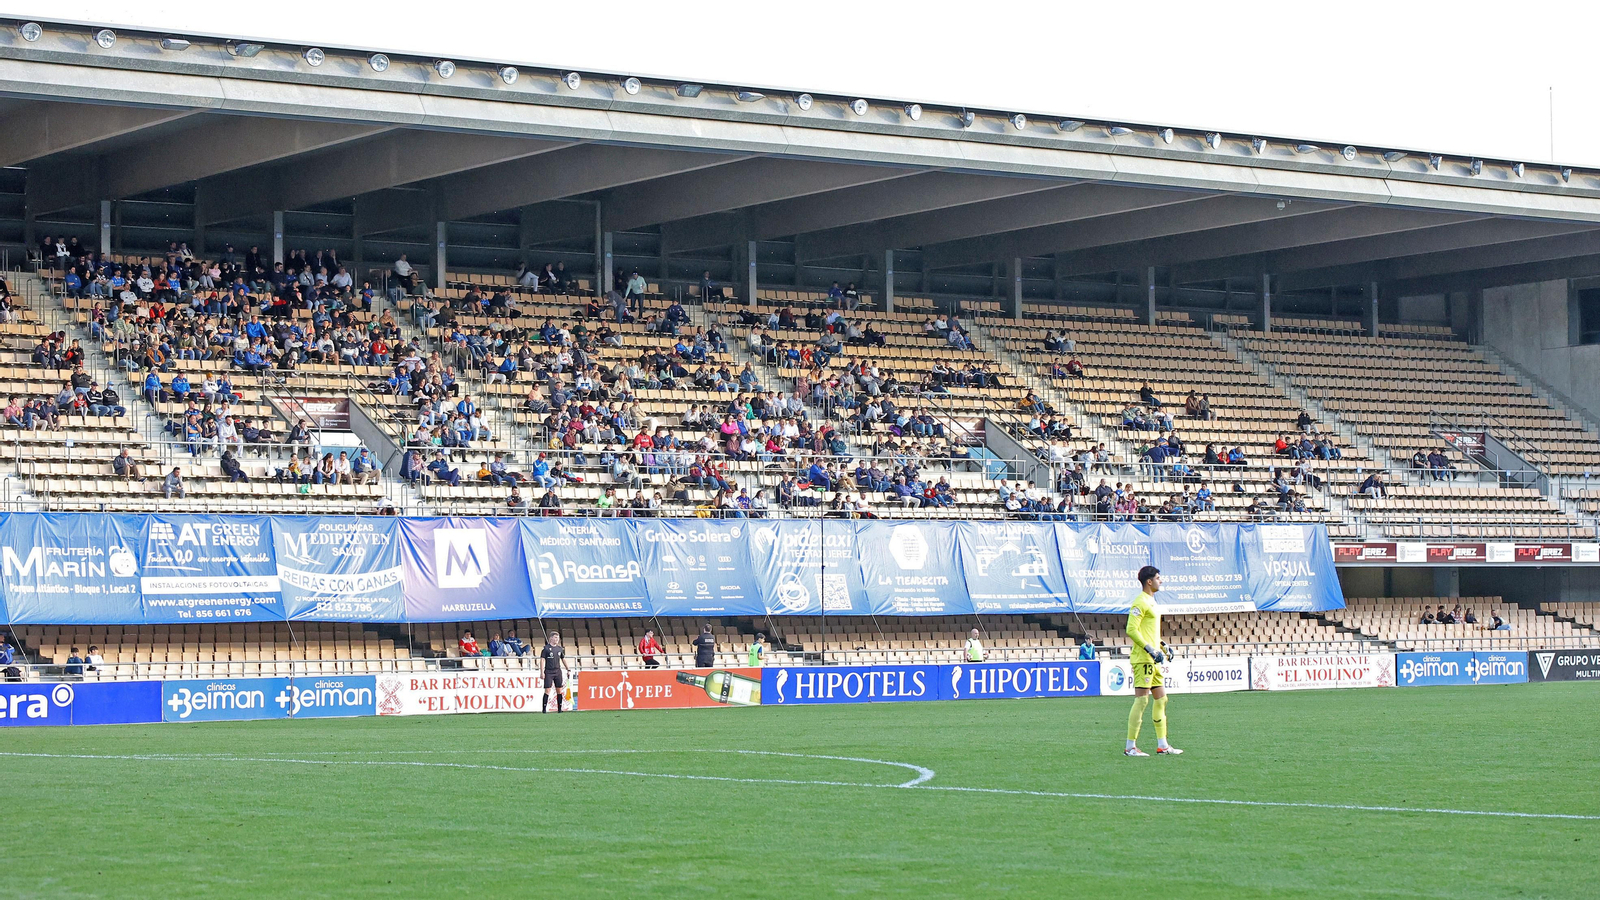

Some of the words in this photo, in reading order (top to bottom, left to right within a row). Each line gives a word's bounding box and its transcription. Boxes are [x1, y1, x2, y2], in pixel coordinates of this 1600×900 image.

[177, 523, 211, 545] AT
[212, 524, 260, 535] GREEN
[559, 526, 600, 535] MATERIAL
[212, 535, 259, 546] ENERGY
[540, 536, 570, 546] MÉDICO
[579, 538, 621, 546] SANITARIO
[645, 530, 687, 544] Grupo
[689, 529, 732, 543] Solera
[281, 532, 390, 558] MEDIPREVEN
[46, 546, 104, 556] FRUTERÍA
[332, 547, 365, 556] SALUD
[828, 549, 853, 558] JEREZ
[1338, 547, 1361, 556] PLAY
[1357, 547, 1387, 560] JEREZ
[1430, 547, 1452, 556] PLAY
[1448, 547, 1477, 560] JEREZ
[1518, 548, 1539, 556] PLAY
[1535, 547, 1563, 560] JEREZ
[2, 546, 105, 577] MARÍN
[1068, 569, 1077, 578] LA
[1078, 569, 1110, 578] CERVEZA
[1170, 575, 1179, 583] 32
[209, 580, 269, 588] FOTOVOLTAICAS
[329, 579, 354, 592] CON
[357, 572, 397, 591] GANAS
[878, 575, 892, 585] LA
[894, 576, 949, 585] TIENDECITA
[1090, 579, 1114, 588] MEJOR
[75, 584, 101, 594] Bloque
[110, 584, 130, 593] Local
[131, 585, 136, 593] 2
[1095, 590, 1105, 598] DE
[1105, 590, 1126, 598] JEREZ
[149, 597, 276, 608] www.atgreenenergy.com
[335, 603, 352, 611] 823
[354, 603, 372, 611] 796
[442, 603, 497, 612] MARRUZELLA
[541, 602, 643, 611] WWW.LATIENDAROANSA.ES
[178, 610, 194, 618] Tel.
[196, 609, 213, 618] 856
[215, 609, 231, 617] 661
[234, 608, 252, 617] 676
[1278, 658, 1297, 667] BAR
[1300, 656, 1371, 666] RESTAURANTE
[1557, 655, 1588, 666] GRUPO
[1143, 664, 1153, 675] 13
[969, 667, 1088, 694] HIPOTELS
[1187, 671, 1205, 682] 956
[1206, 670, 1224, 681] 900
[1226, 669, 1242, 680] 102
[410, 678, 438, 690] BAR
[442, 677, 542, 690] RESTAURANTE
[795, 671, 926, 699] HIPOTELS
[589, 685, 616, 699] TIO
[635, 685, 672, 698] PEPE
